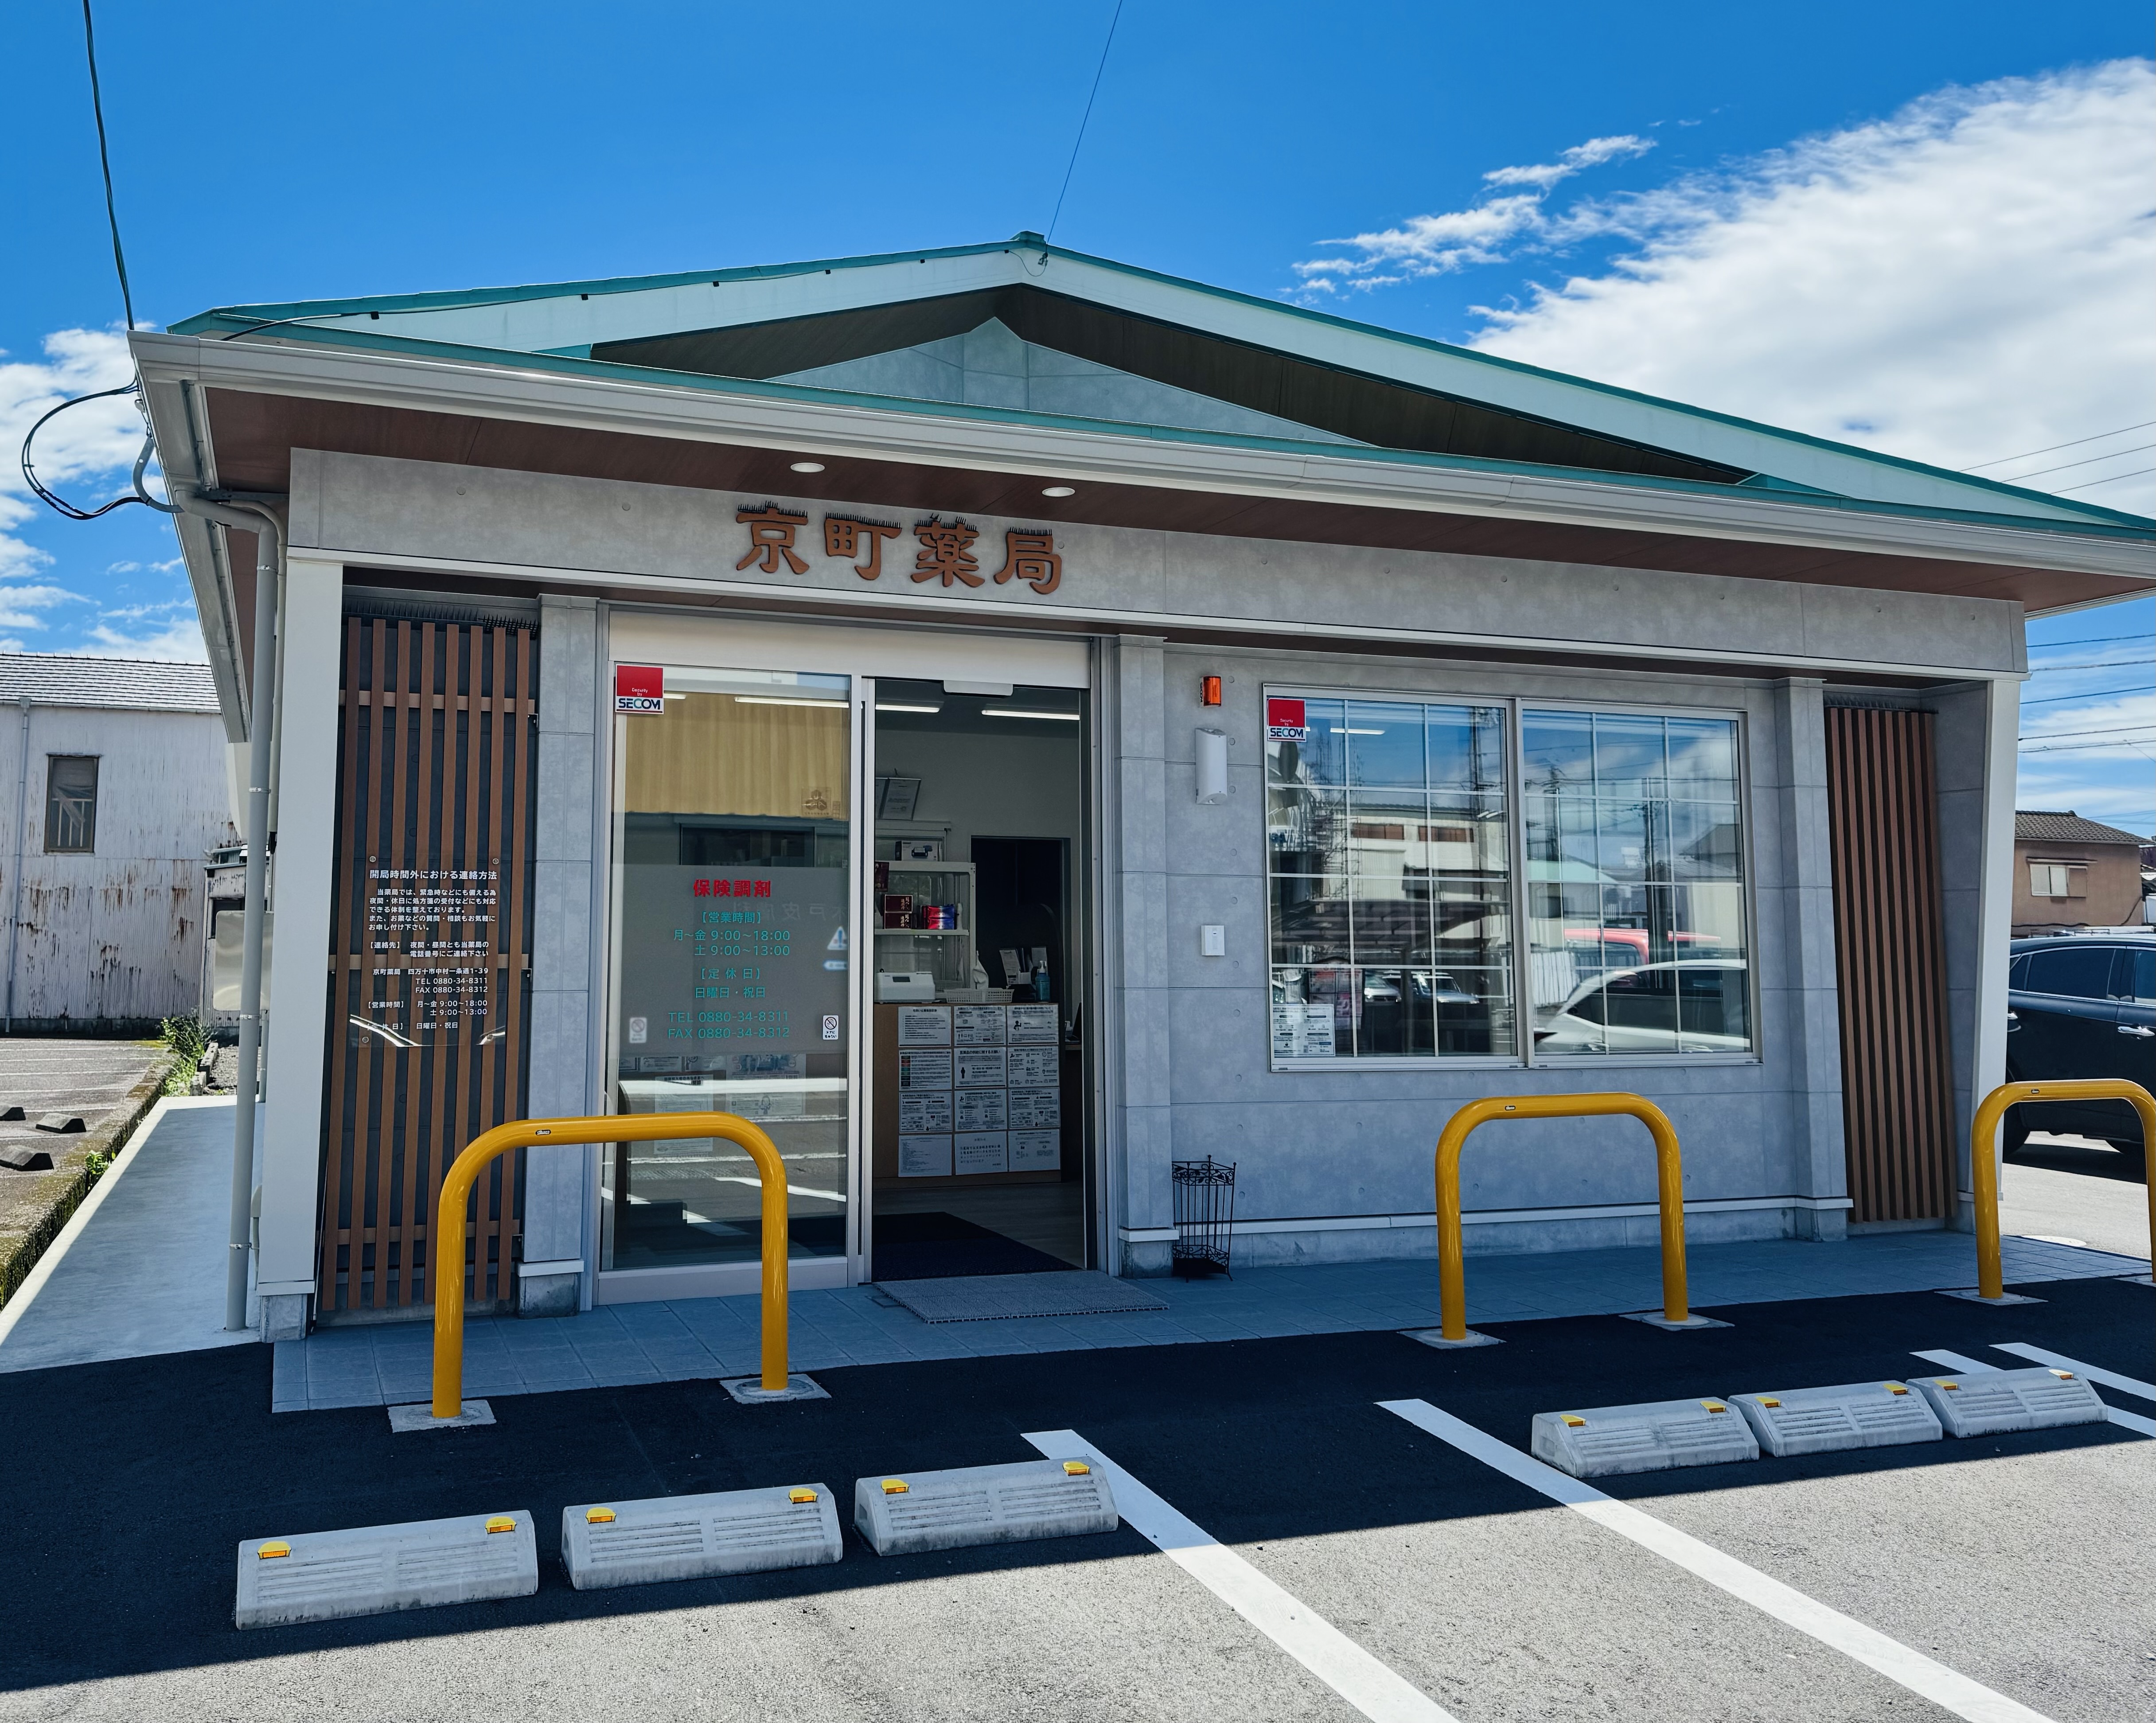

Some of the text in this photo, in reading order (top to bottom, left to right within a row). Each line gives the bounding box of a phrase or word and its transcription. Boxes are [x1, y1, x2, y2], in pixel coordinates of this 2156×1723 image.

[736, 507, 1063, 595] 京町薬局
[618, 698, 660, 710] SECOM
[1270, 728, 1303, 738] SECOM
[370, 869, 497, 880] 開局時間外における連絡方法
[693, 879, 771, 898] 保険調剤
[702, 912, 761, 924] 【営業時間】
[694, 944, 706, 955] 土
[695, 986, 765, 998] 日曜日・祝日
[668, 1011, 788, 1023] TEL 0880-34-8311
[668, 1027, 790, 1039] FAX 0880-34-8312
